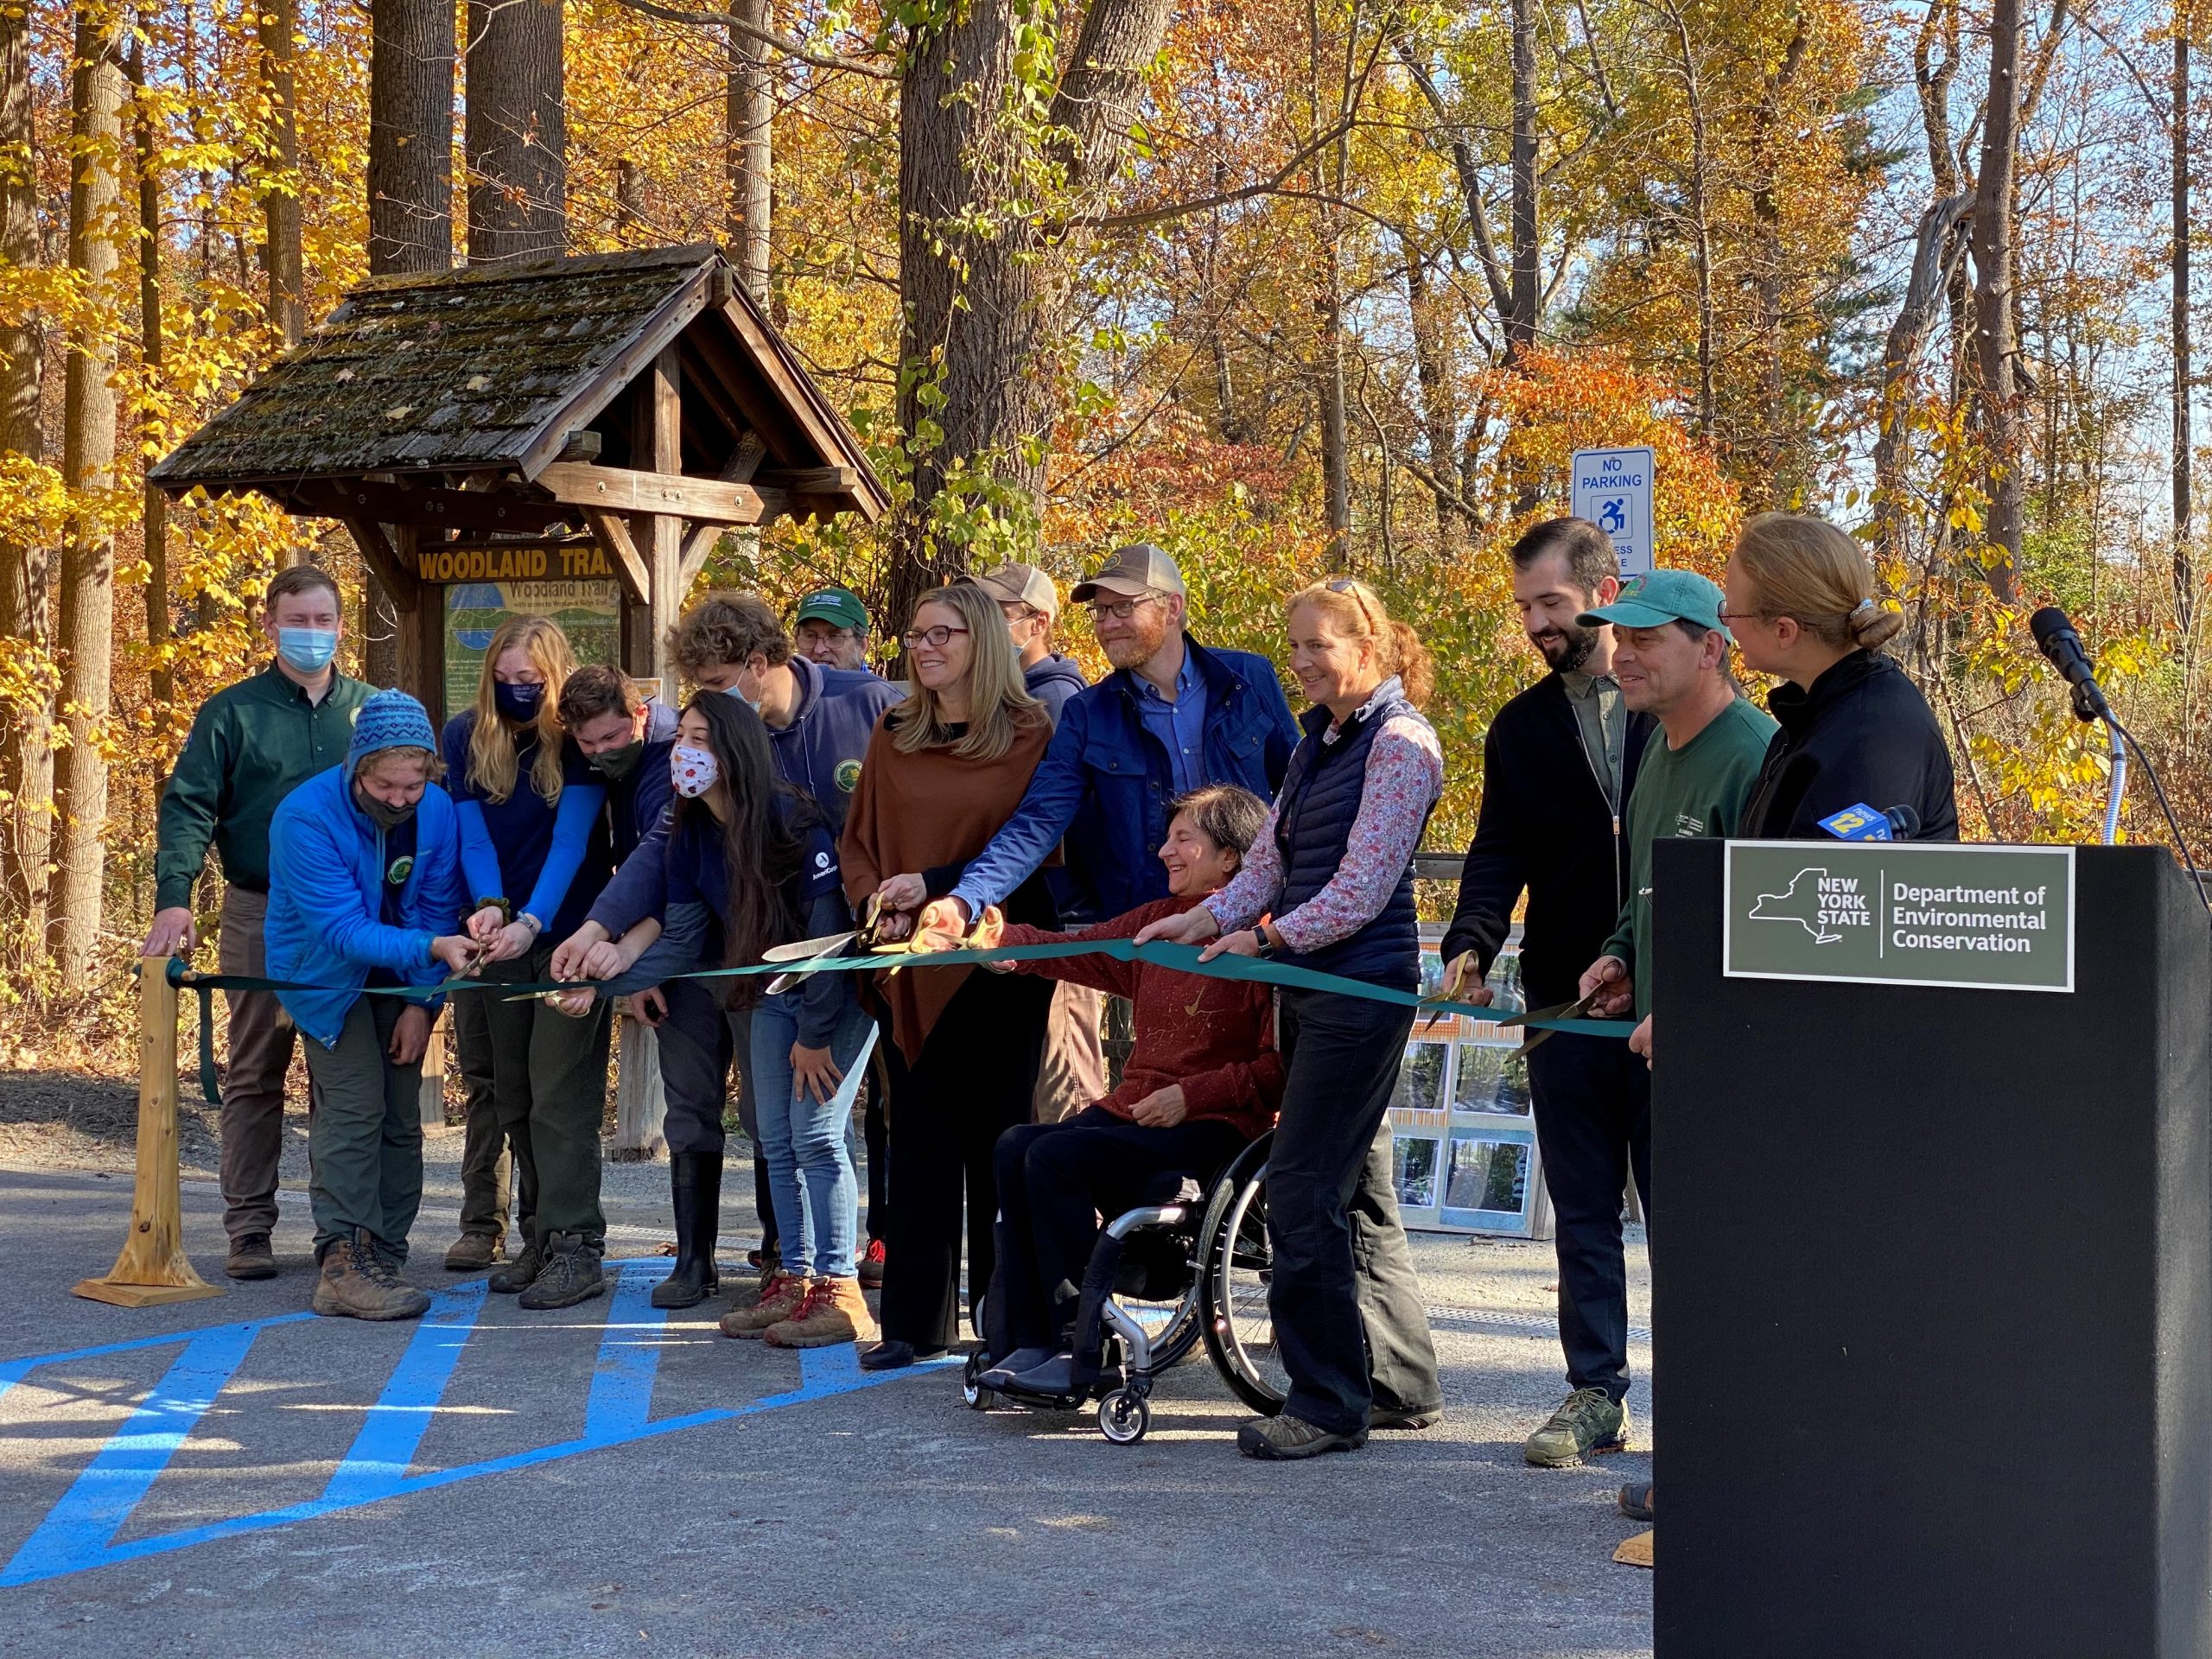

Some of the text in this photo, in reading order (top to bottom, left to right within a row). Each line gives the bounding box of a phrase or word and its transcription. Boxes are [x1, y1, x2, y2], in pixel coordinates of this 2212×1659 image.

[1603, 459, 1622, 472] NO
[1582, 474, 1642, 489] PARKING
[1614, 545, 1633, 554] ESS
[418, 548, 613, 579] WOODLAND TRA
[510, 580, 608, 598] Woodland Trail
[1852, 807, 1877, 822] news
[1829, 813, 1865, 834] 12
[1817, 878, 1858, 893] NEW
[1817, 893, 1866, 909] YORK
[1893, 882, 2047, 907] Department of
[1817, 910, 1870, 925] STATE
[1893, 906, 2046, 930] Environmental
[1892, 930, 2031, 953] Conservation
